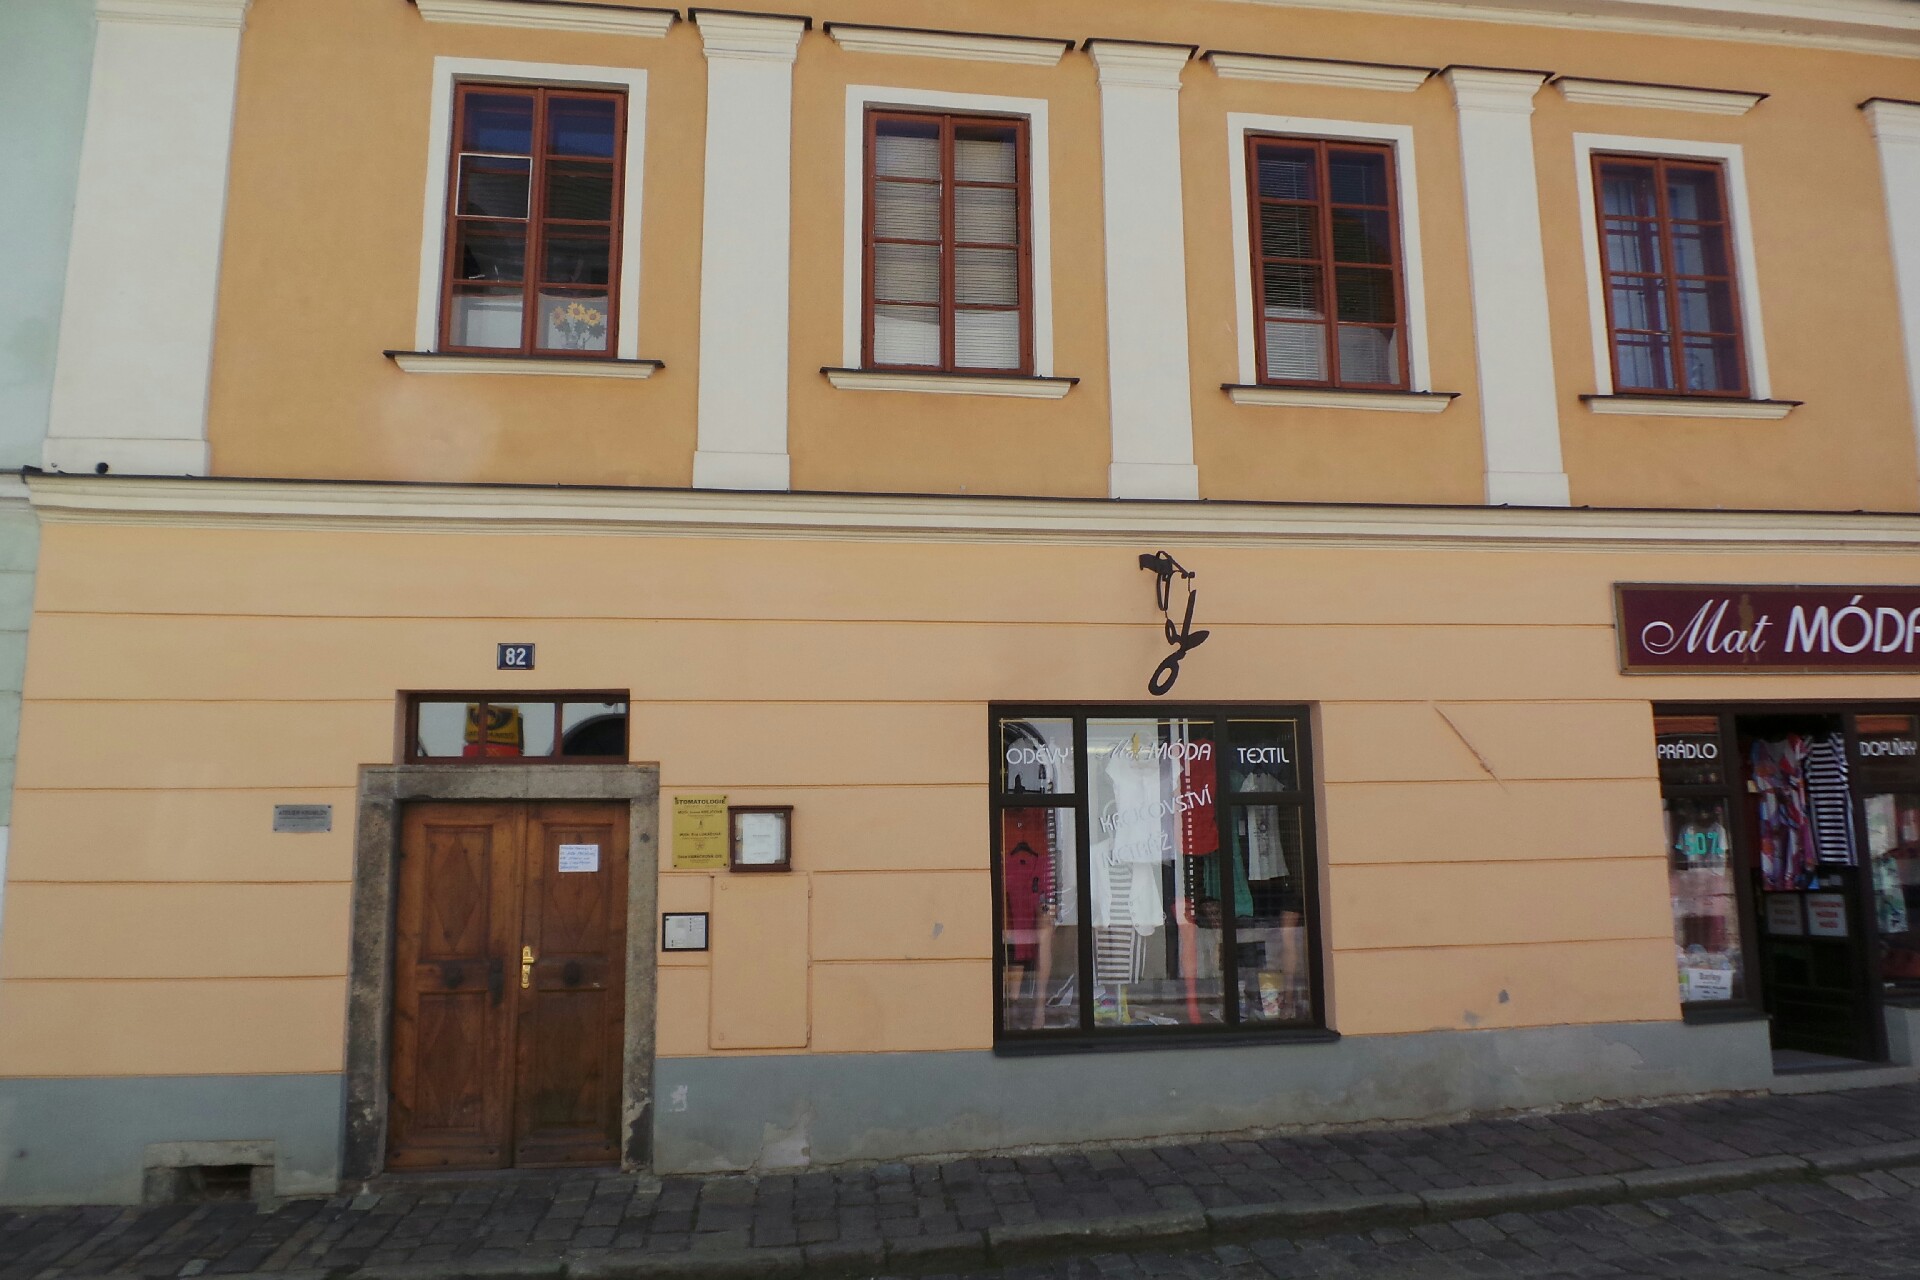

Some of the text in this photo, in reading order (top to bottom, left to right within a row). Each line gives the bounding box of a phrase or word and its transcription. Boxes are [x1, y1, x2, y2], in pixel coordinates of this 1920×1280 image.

[1641, 599, 1774, 655] Mat
[505, 647, 526, 666] 82
[1006, 743, 1069, 765] ODĚVY
[1148, 738, 1212, 761] MÓDA
[1236, 747, 1290, 764] TEXTIL
[1657, 739, 1719, 759] PRÁDLO
[1858, 737, 1918, 756] DOPLŇKY
